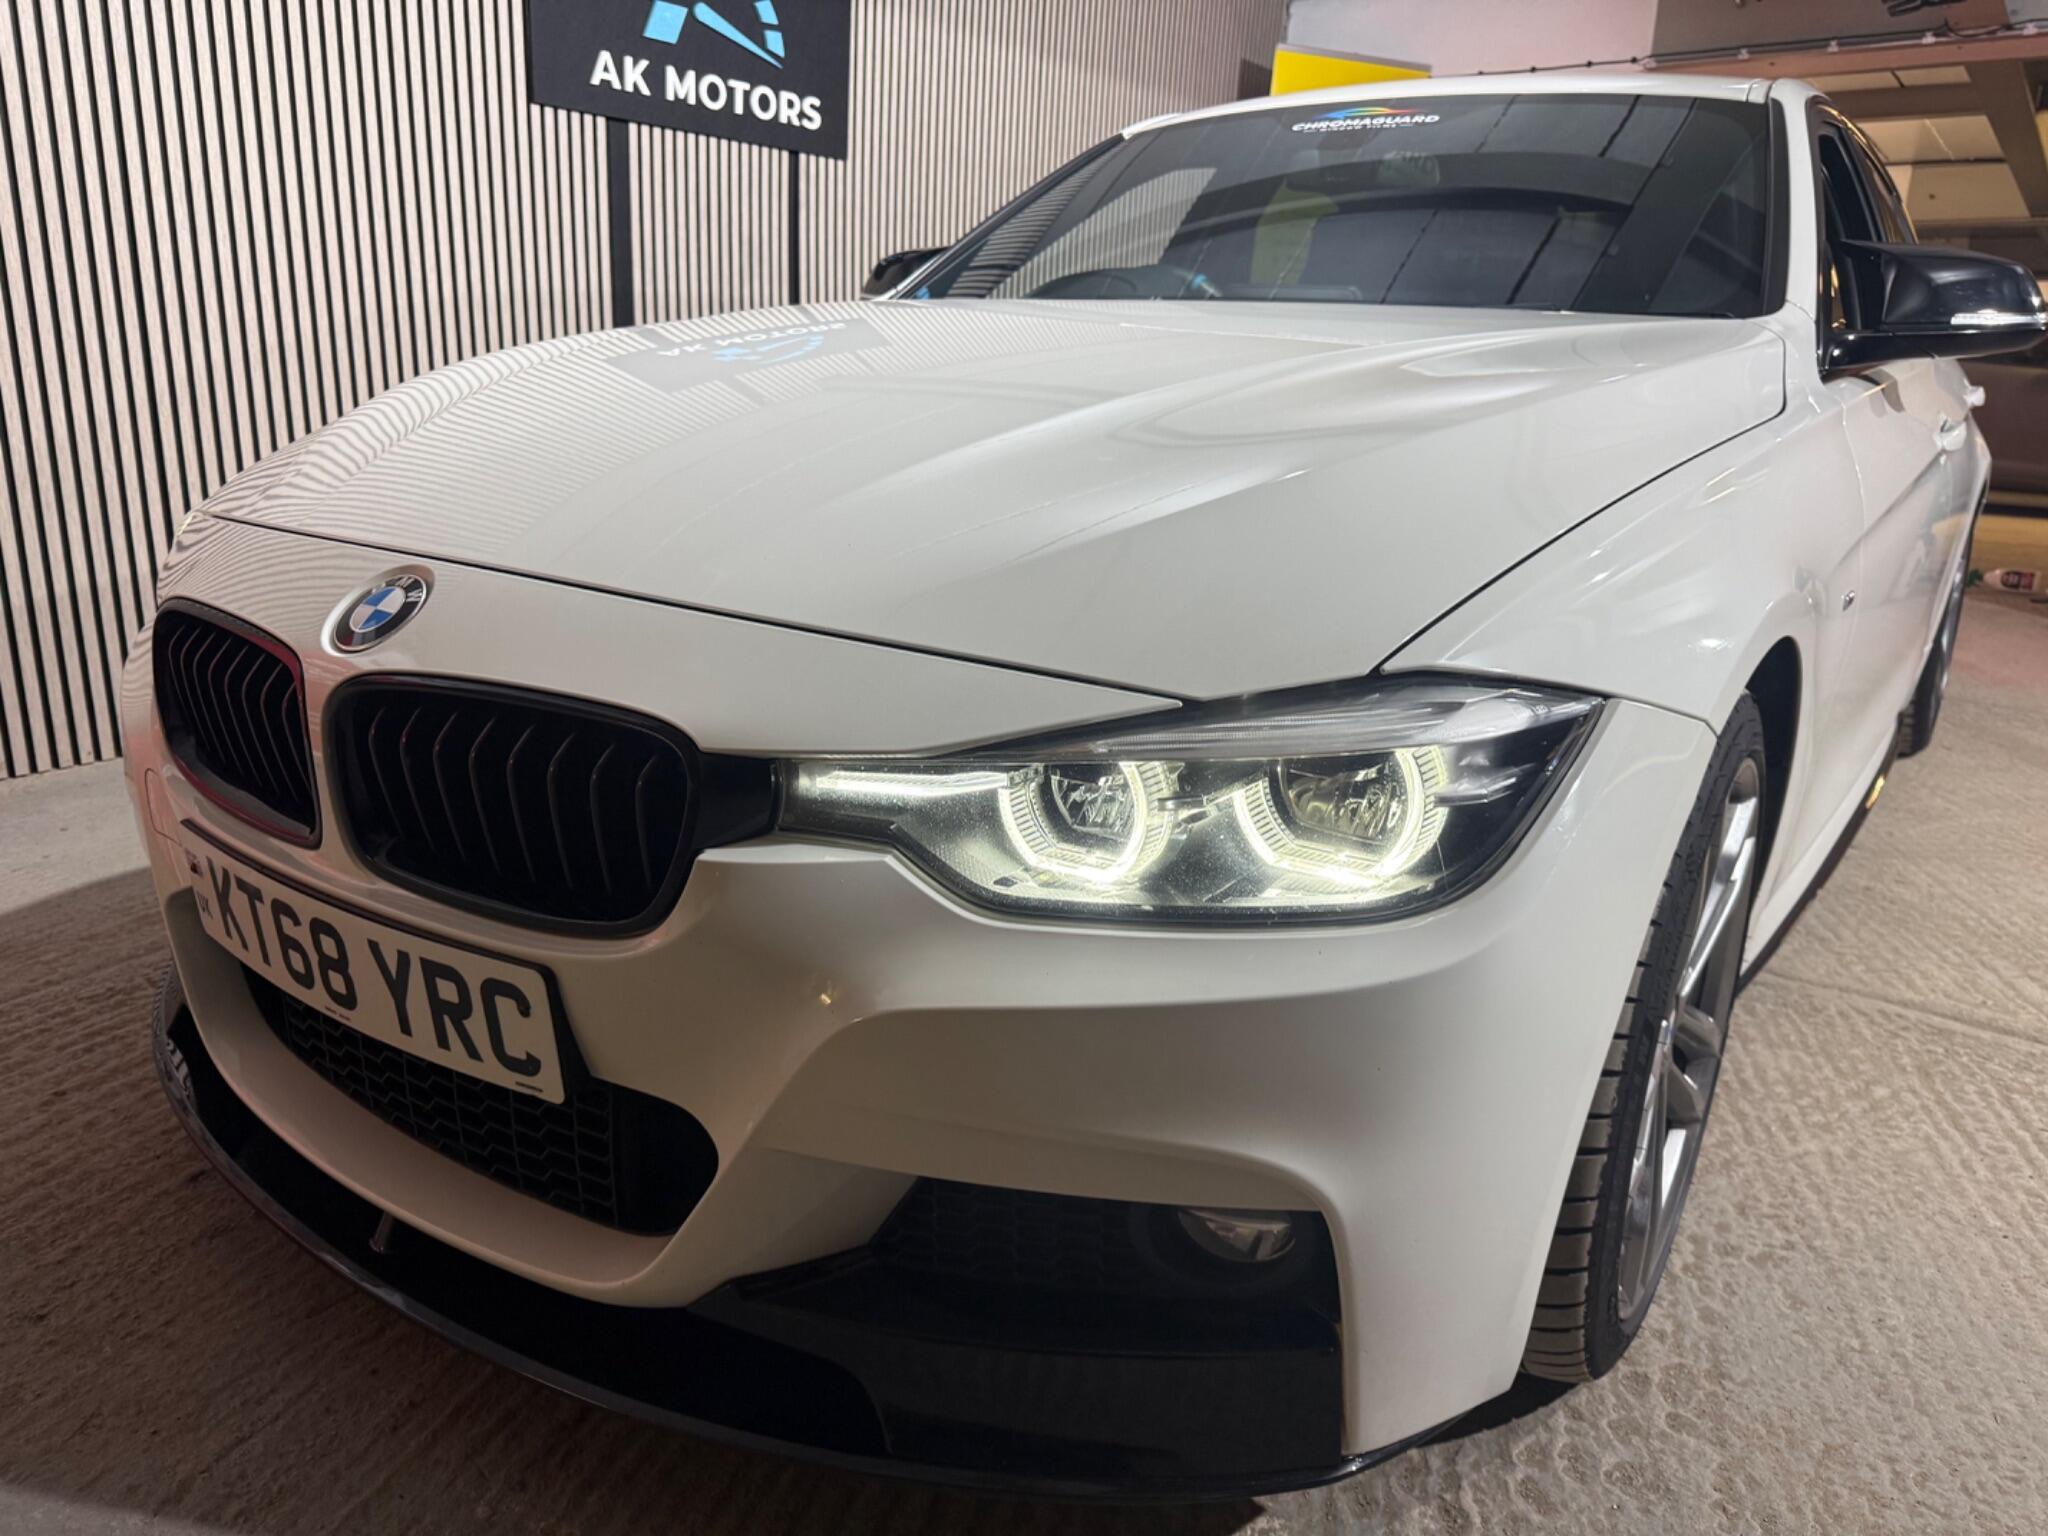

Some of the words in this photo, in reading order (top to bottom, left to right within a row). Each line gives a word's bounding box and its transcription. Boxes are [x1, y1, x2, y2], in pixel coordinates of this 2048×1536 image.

[590, 50, 651, 96] AK
[664, 64, 822, 131] MOTORS
[1291, 115, 1440, 132] CHROMAGUARD
[205, 855, 358, 1012] KT68
[366, 937, 542, 1077] YRC
